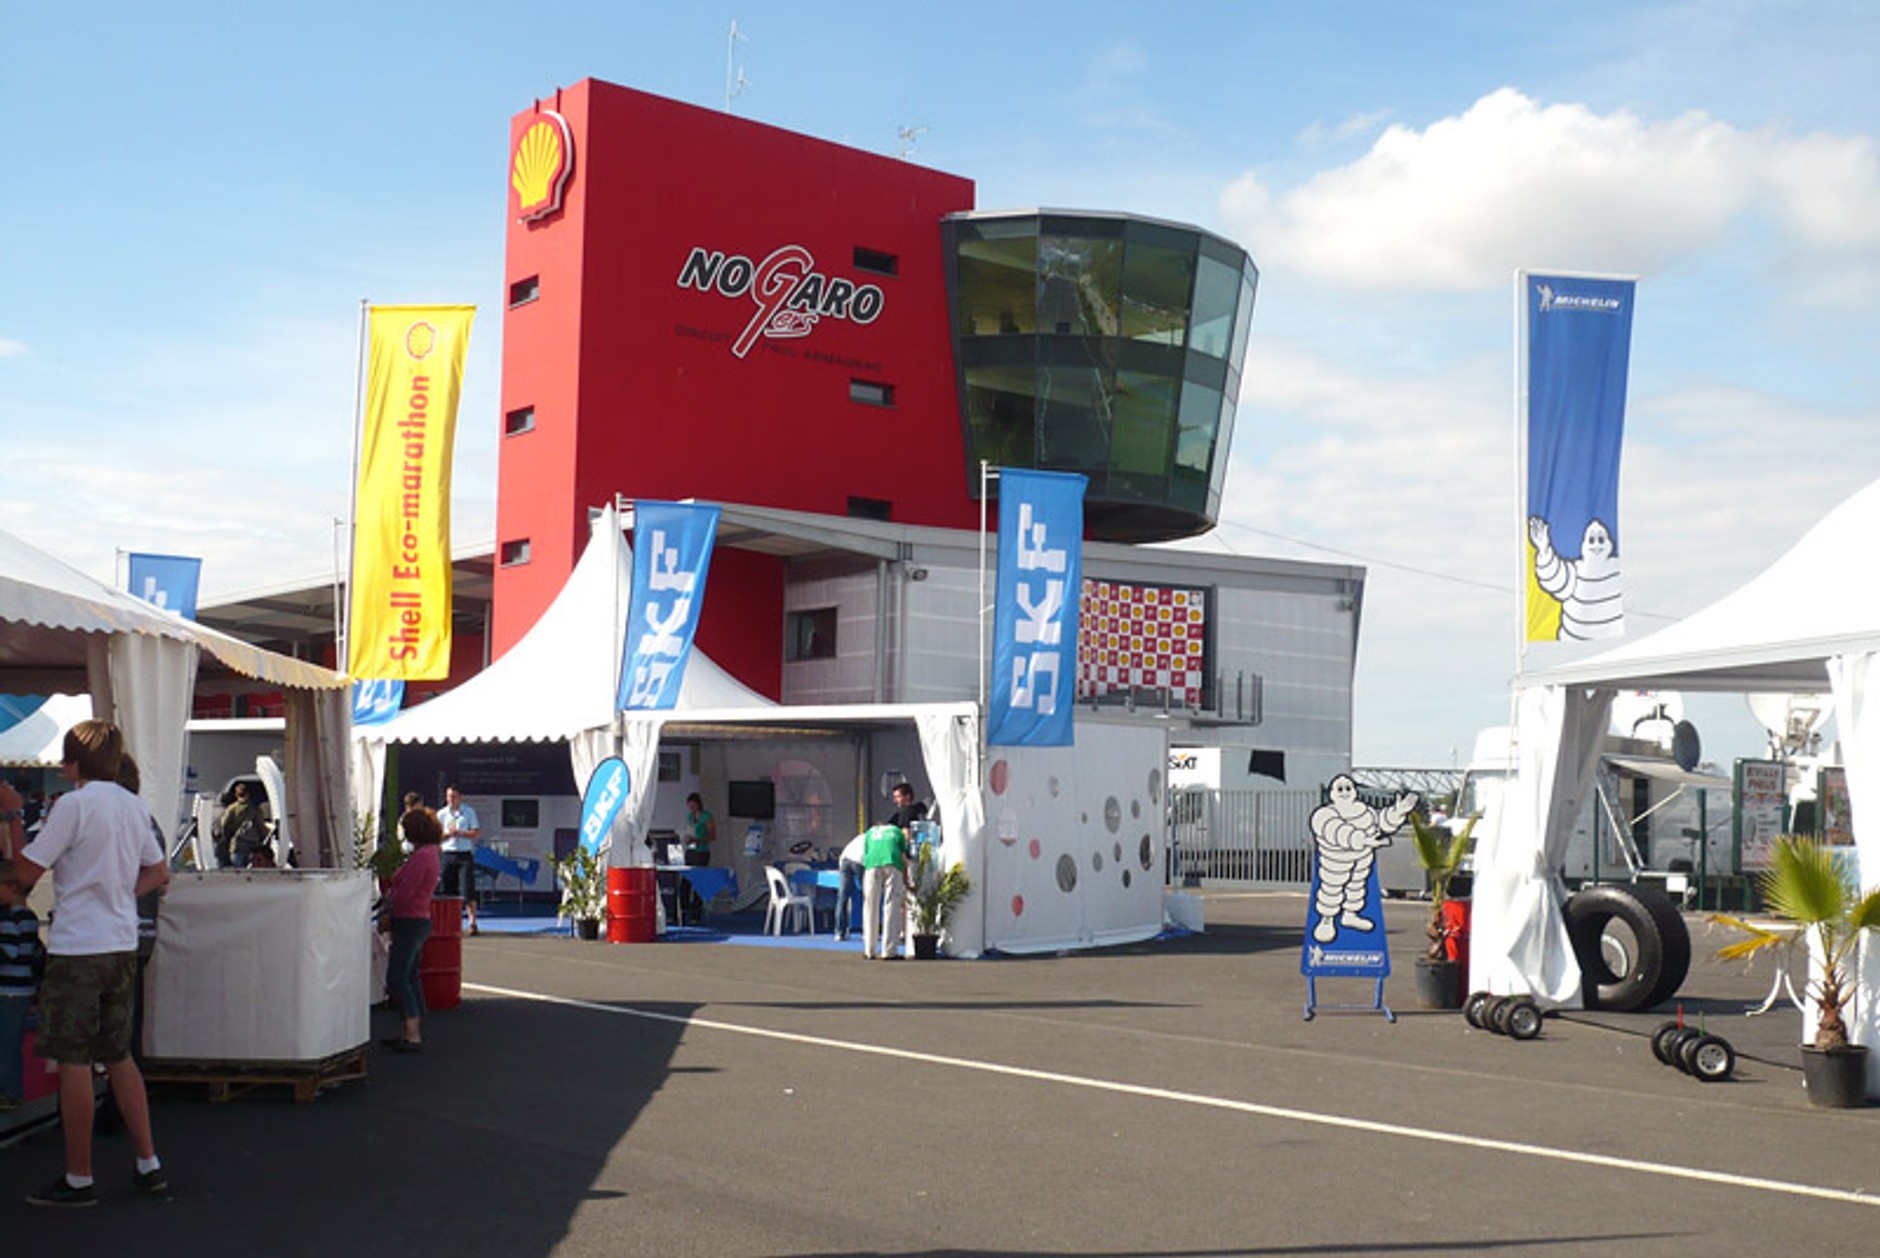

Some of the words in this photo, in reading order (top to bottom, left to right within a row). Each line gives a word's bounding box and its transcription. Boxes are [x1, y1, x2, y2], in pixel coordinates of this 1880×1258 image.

[677, 245, 883, 357] NOGARO
[1555, 295, 1619, 309] MICHELIN
[392, 375, 430, 580] Eco-marathon
[388, 591, 421, 661] Shell
[627, 530, 695, 707] SKF
[1010, 503, 1066, 714] SKF
[583, 766, 622, 843] SKF
